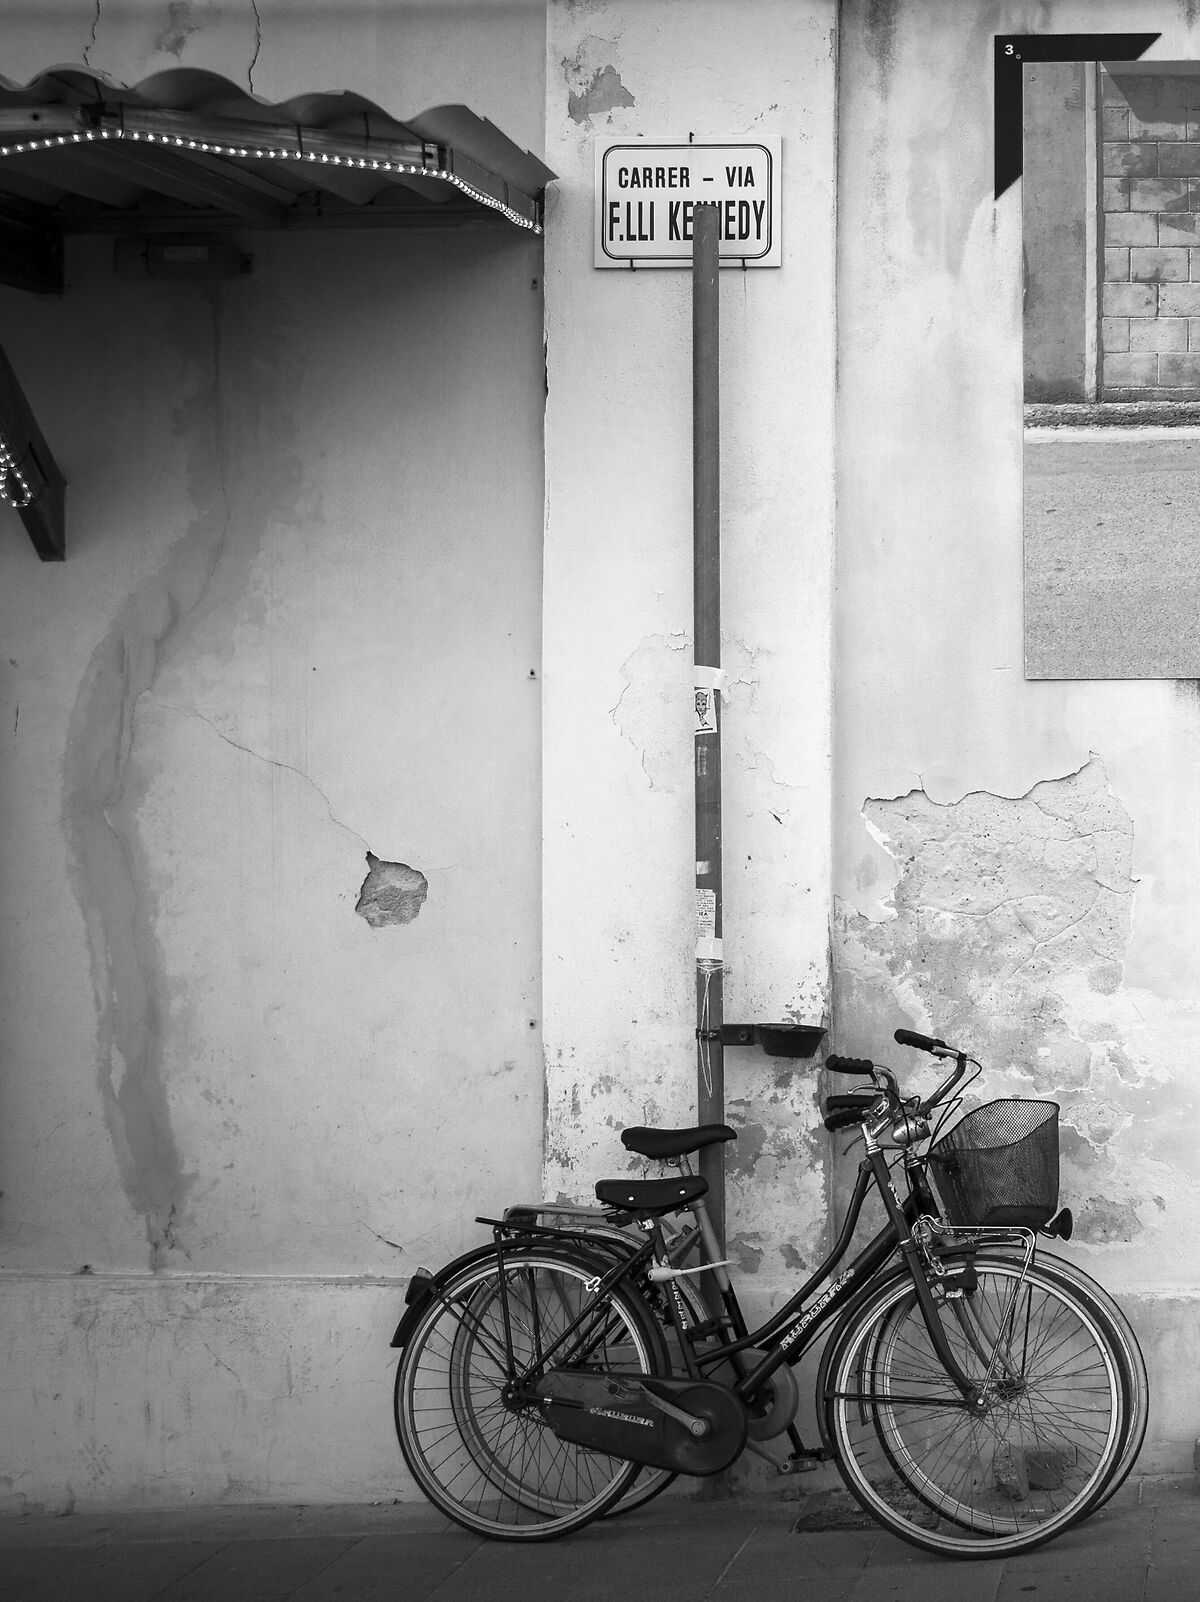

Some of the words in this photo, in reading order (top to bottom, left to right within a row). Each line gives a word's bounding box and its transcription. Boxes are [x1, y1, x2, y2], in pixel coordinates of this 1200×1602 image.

[1005, 44, 1014, 55] 3
[618, 166, 690, 188] CARRER
[725, 166, 755, 188] VIA
[609, 201, 655, 241] F.LLI
[668, 200, 766, 241] KEEDY
